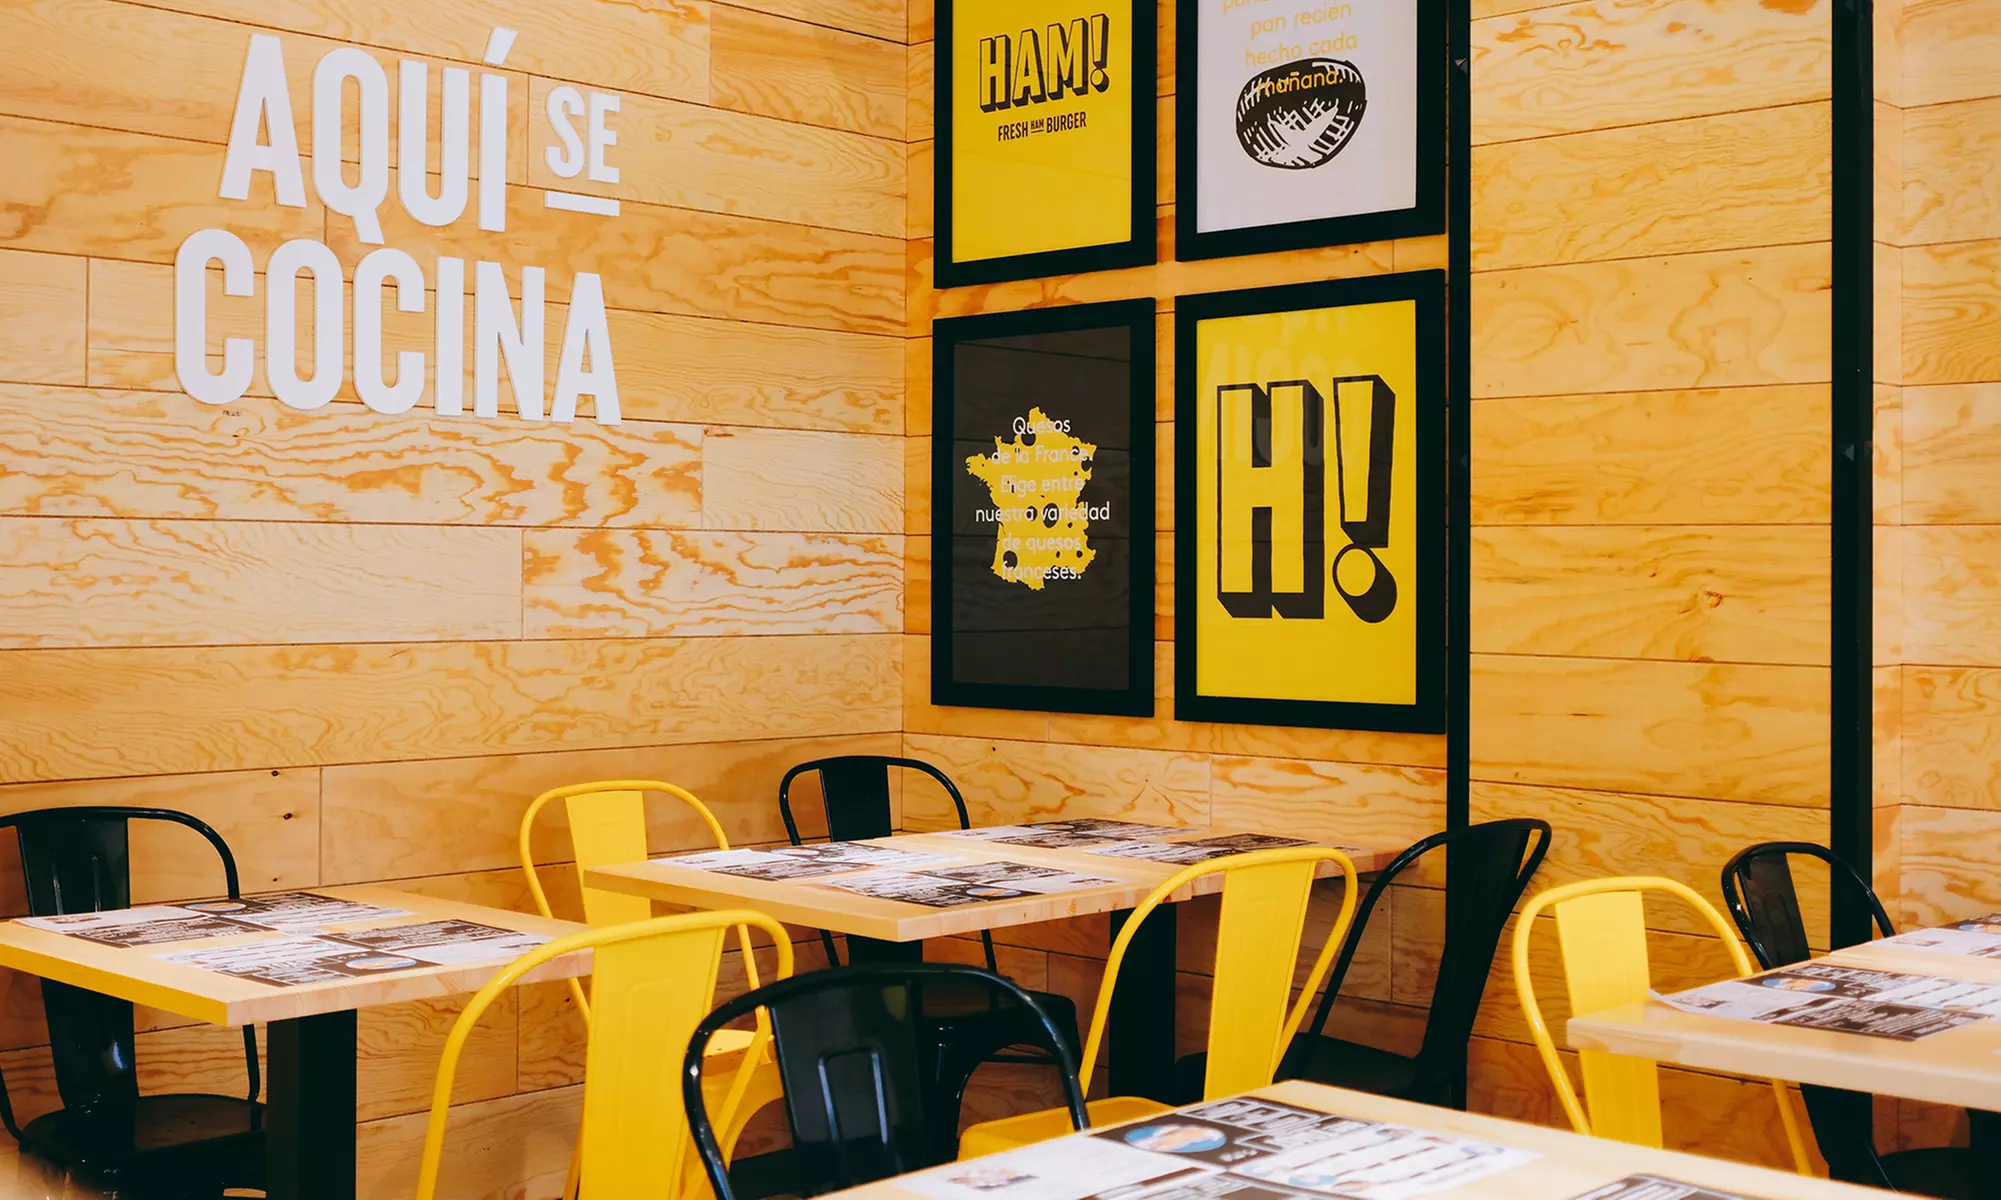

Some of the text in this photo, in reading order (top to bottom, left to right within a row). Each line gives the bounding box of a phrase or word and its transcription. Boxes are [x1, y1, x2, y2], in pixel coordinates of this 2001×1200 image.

[1251, 16, 1286, 40] pan
[1245, 32, 1357, 67] hecho cada
[980, 13, 1110, 113] HAM!
[1257, 71, 1344, 98] mañana.
[219, 27, 620, 245] AQUÍ SE
[998, 111, 1087, 141] FRESH HAM BURGER
[174, 228, 622, 425] COCINA
[1013, 416, 1071, 434] Quesos
[992, 447, 1011, 464] de
[1015, 446, 1029, 464] la
[1000, 475, 1084, 497] Elige entre
[1217, 374, 1398, 623] H!
[975, 501, 1111, 522] nuestra variedad
[1002, 533, 1081, 555] de quesos
[1001, 560, 1083, 580] franceses.
